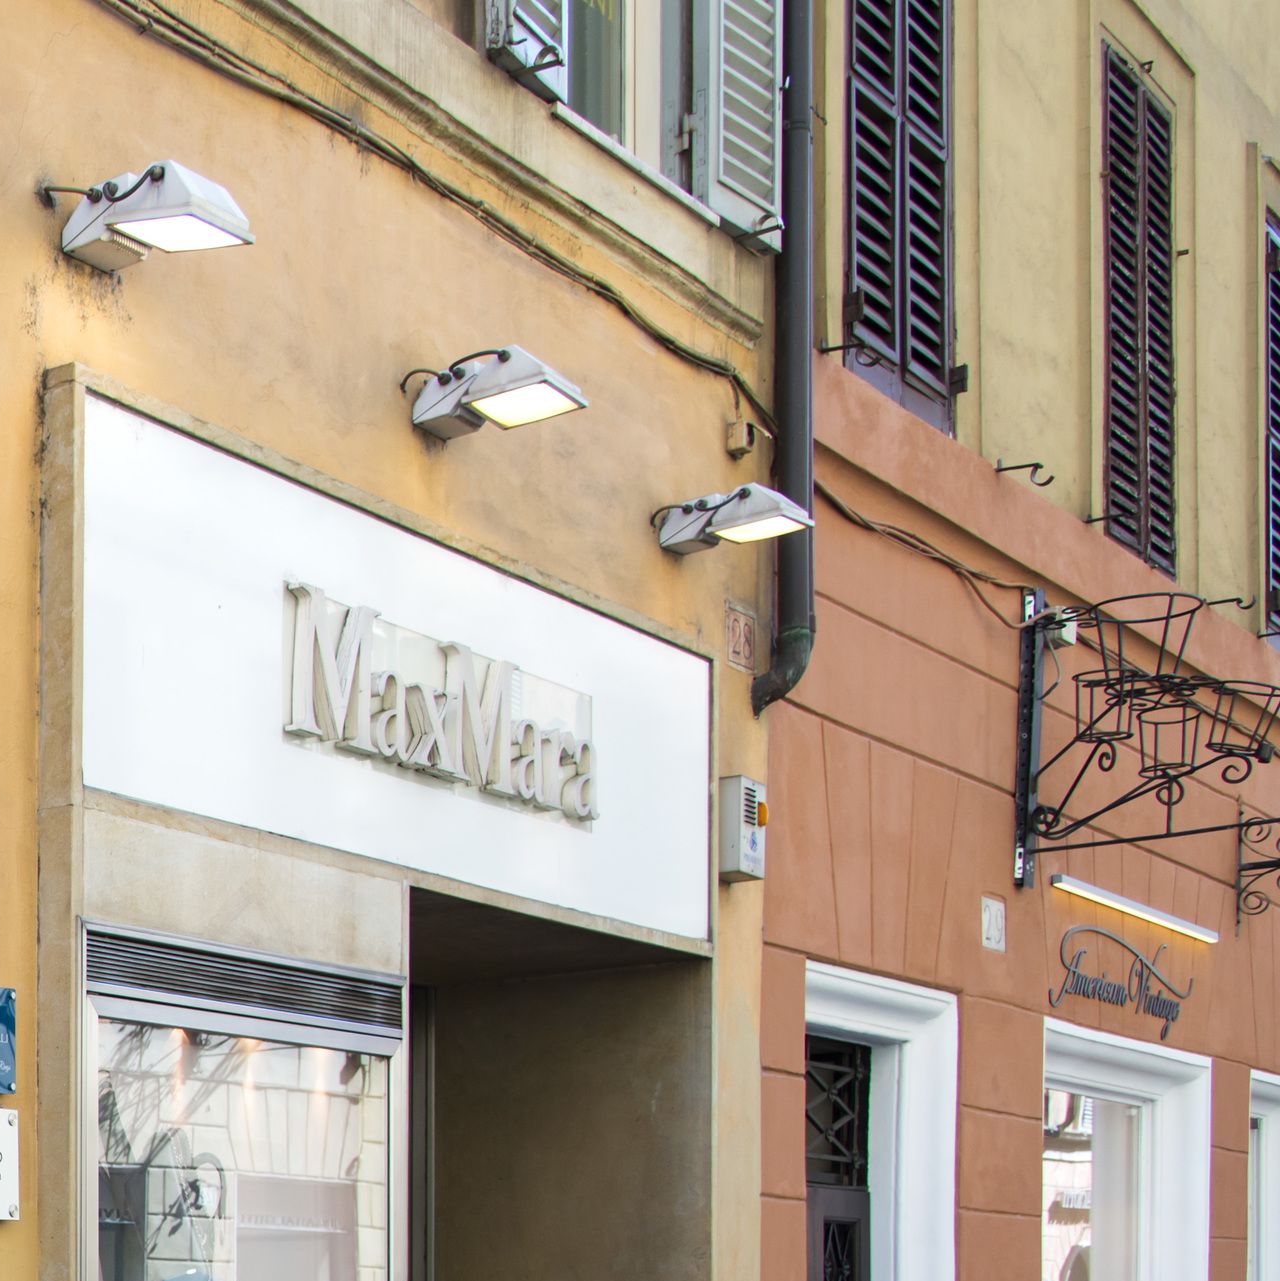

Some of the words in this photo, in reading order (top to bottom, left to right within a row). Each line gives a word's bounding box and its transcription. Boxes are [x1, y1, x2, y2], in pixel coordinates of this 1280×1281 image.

[731, 617, 753, 661] 28
[284, 580, 600, 820] MaxMara
[983, 903, 1005, 945] 29
[1048, 926, 1130, 1009] American
[1127, 943, 1183, 1041] Vintage
